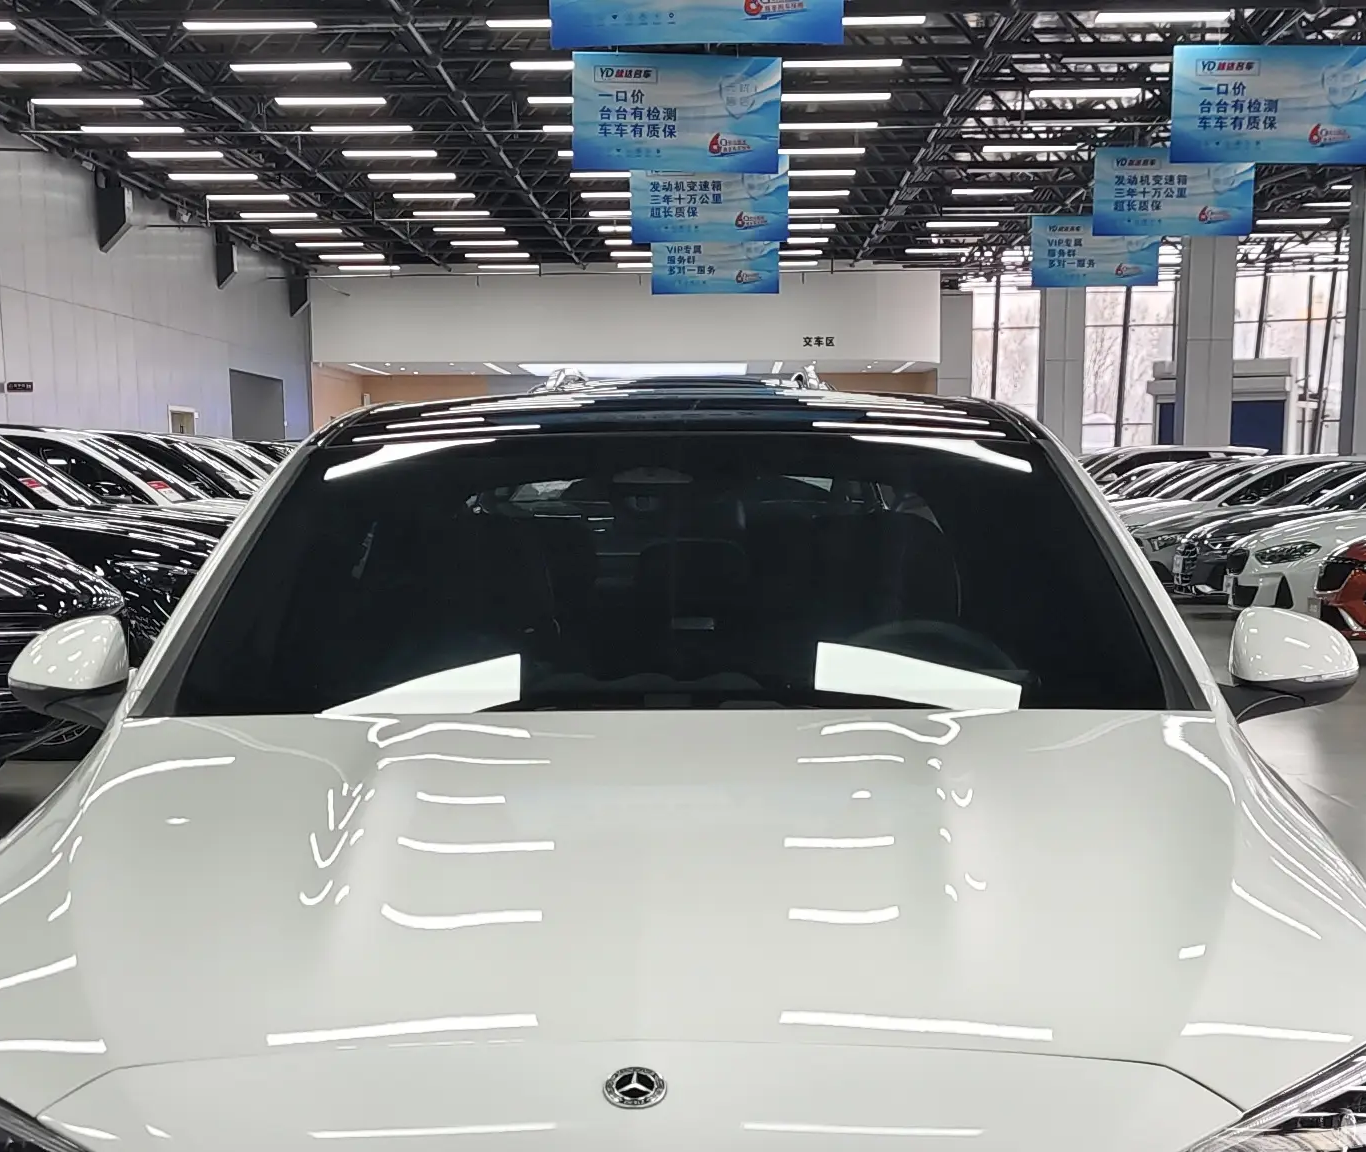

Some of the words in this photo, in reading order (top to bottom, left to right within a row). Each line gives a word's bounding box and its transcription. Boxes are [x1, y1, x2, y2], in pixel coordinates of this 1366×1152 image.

[1199, 82, 1246, 96] 一口价
[598, 89, 645, 103] 一口价
[1198, 99, 1279, 114] 台台有检测
[598, 106, 677, 122] 台台有检测
[1197, 115, 1278, 131] 车车有质保
[598, 123, 677, 139] 车车有质保
[649, 181, 722, 192] 发动机变速箱
[1114, 175, 1188, 186] 发动机变速箱
[649, 194, 723, 205] 三年十万公里
[1114, 188, 1187, 198] 三年十万公里
[650, 206, 698, 218] 超长质保
[802, 336, 835, 347] 交车区
